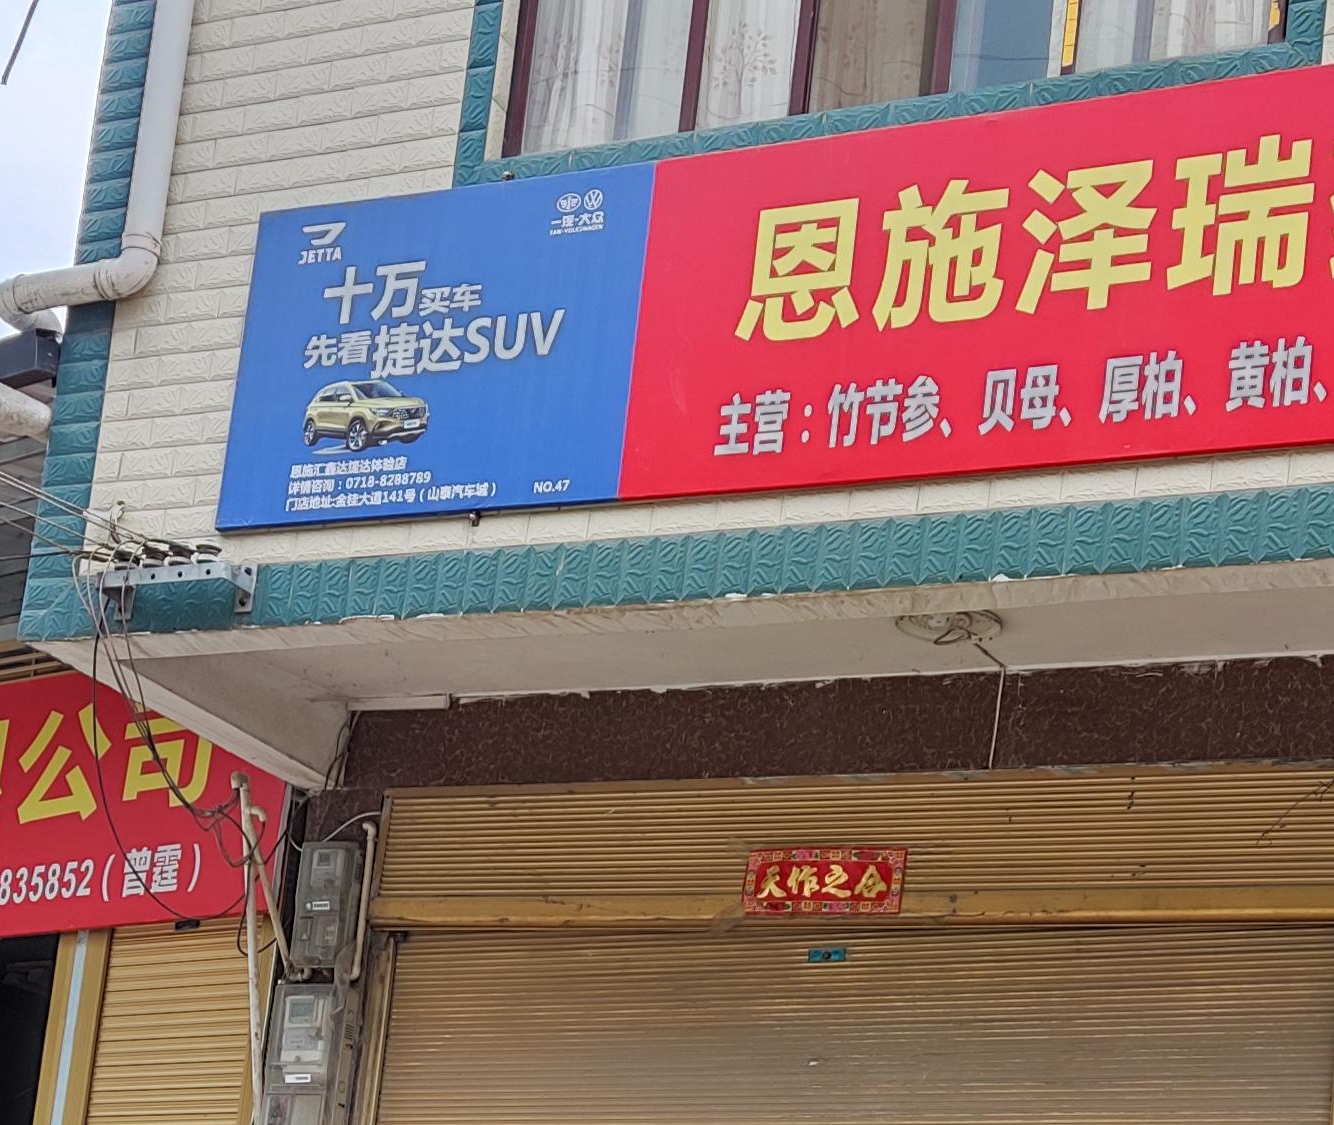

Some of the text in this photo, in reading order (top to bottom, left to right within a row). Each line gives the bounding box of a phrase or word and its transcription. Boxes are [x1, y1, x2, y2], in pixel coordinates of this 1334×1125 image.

[299, 247, 342, 265] JETTA
[323, 260, 482, 325] 十万买车
[303, 309, 565, 379] 先看捷达SUV
[534, 480, 571, 494] NO.47
[756, 864, 887, 898] 天作之合
